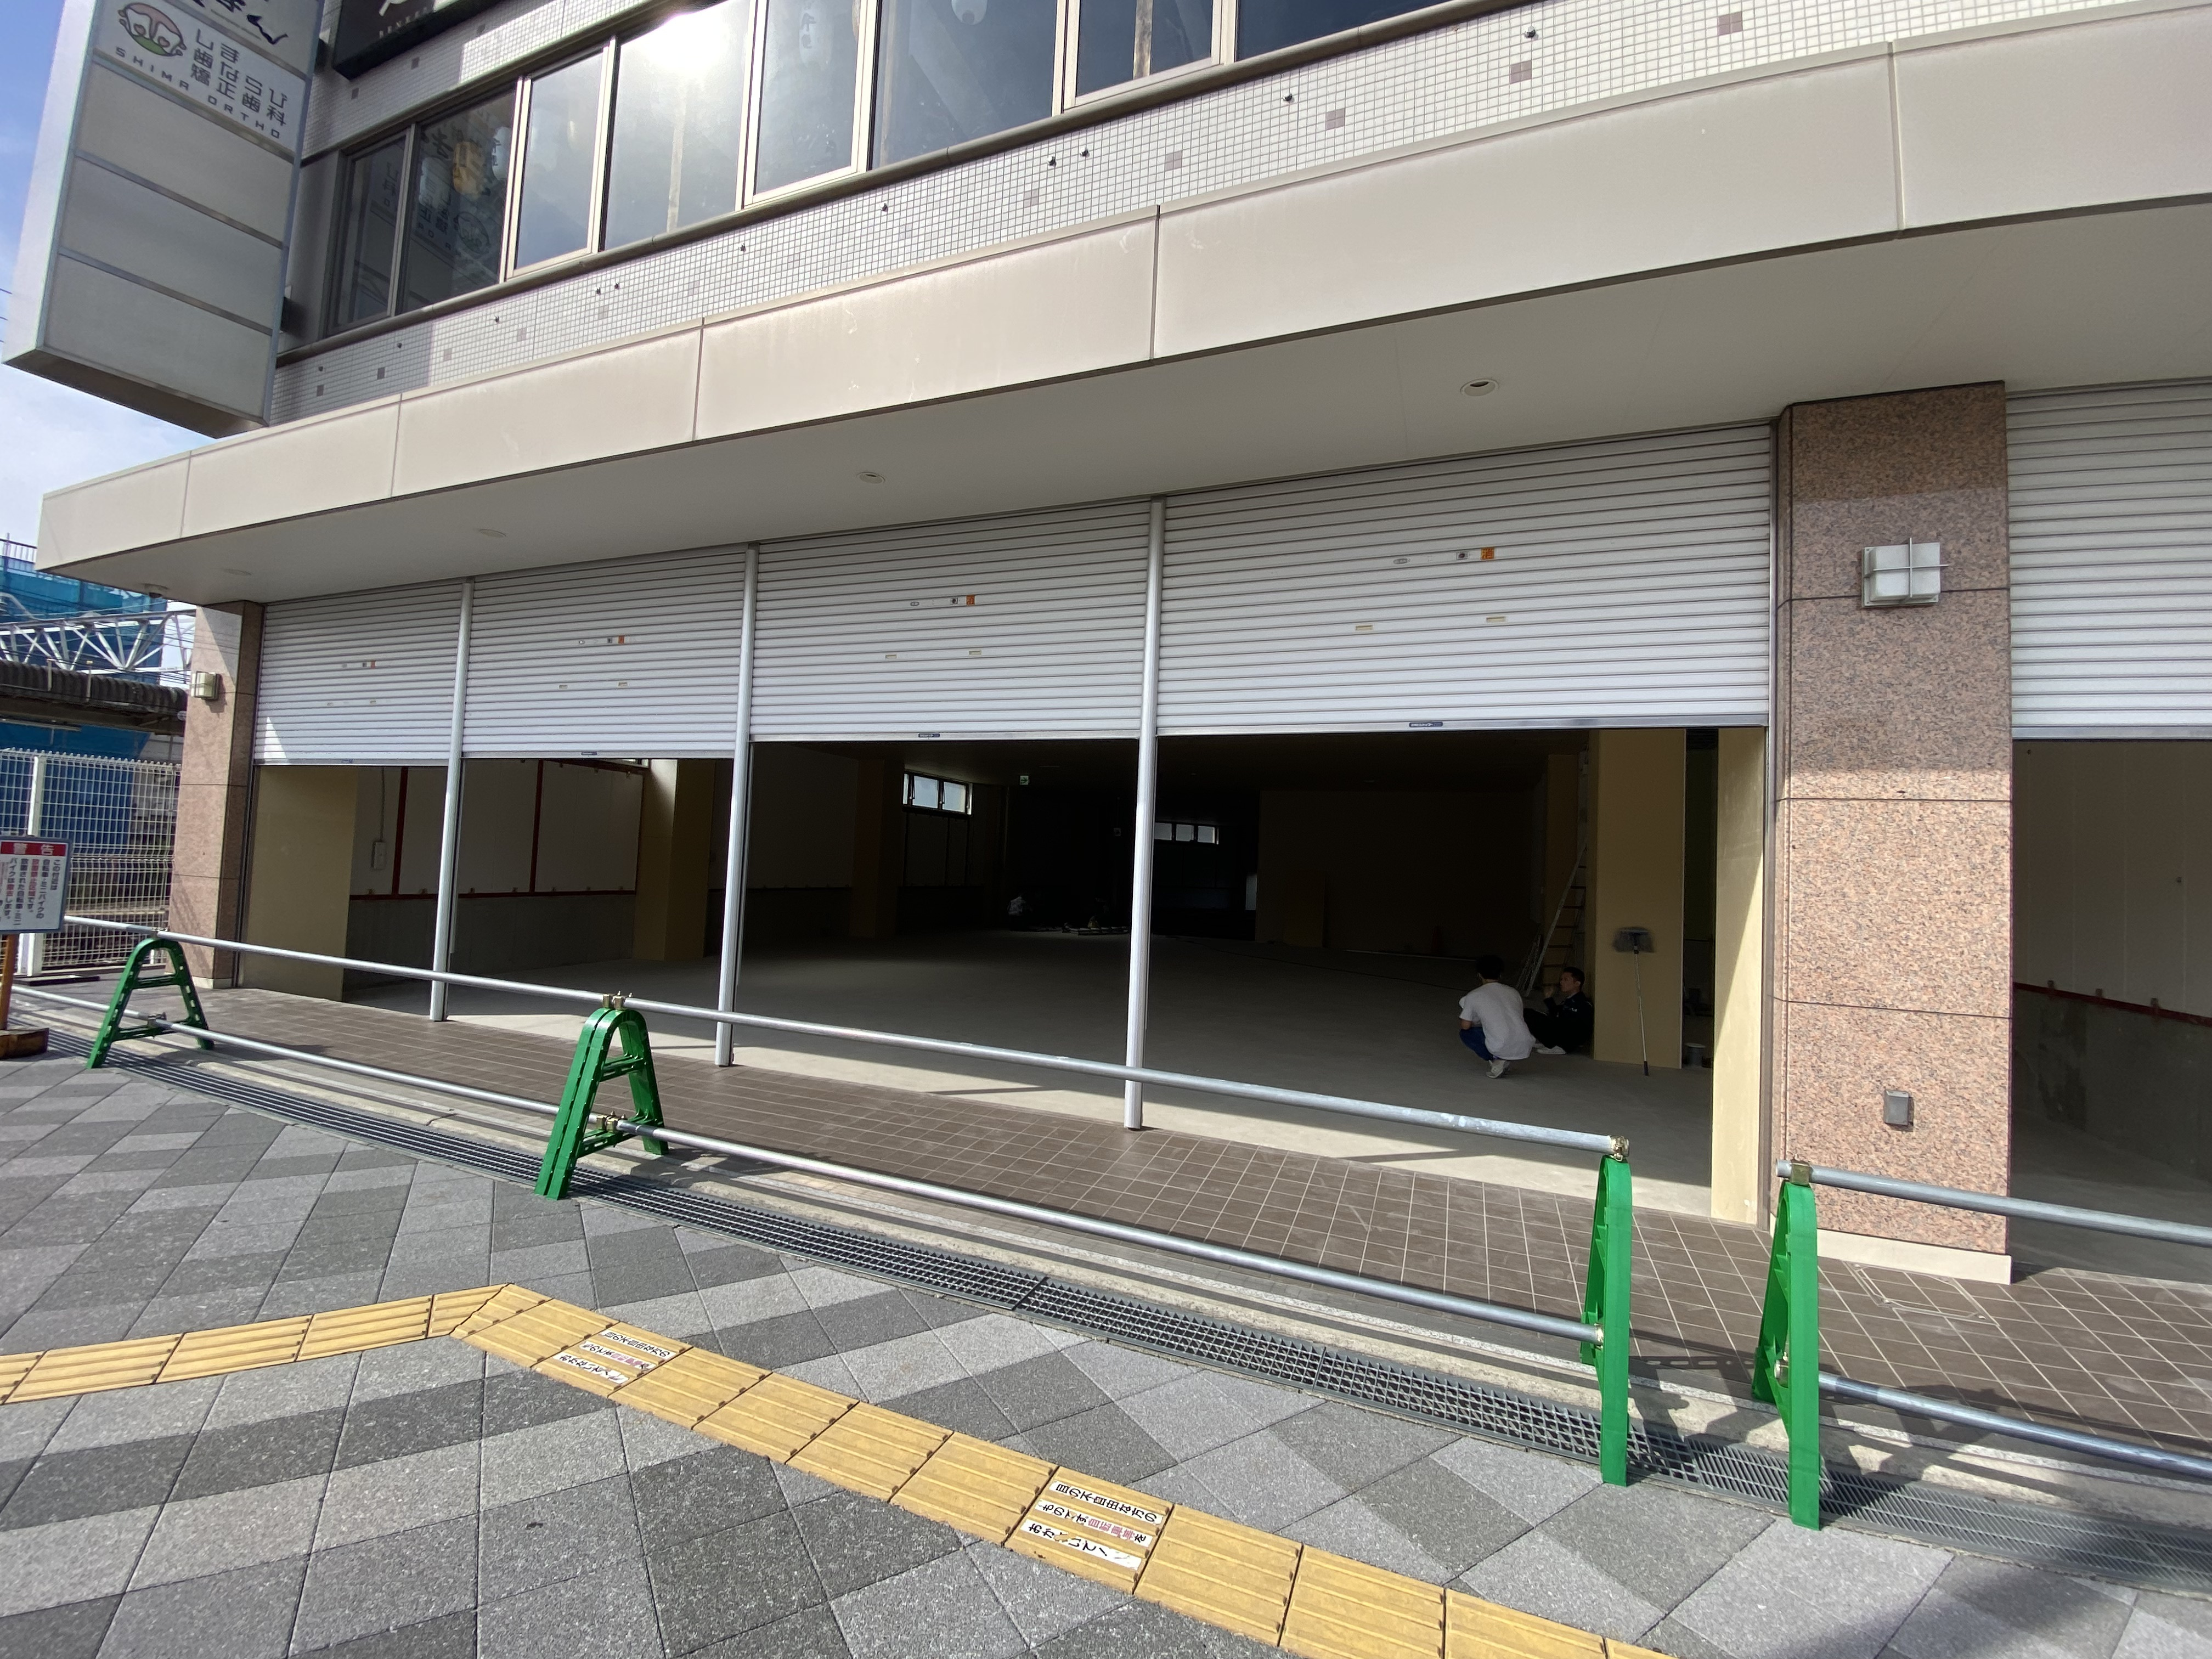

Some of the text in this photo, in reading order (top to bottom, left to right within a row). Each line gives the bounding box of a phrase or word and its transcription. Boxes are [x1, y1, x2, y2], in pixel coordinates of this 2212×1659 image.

[116, 46, 280, 139] SHIMA ORTHO
[189, 64, 286, 127] 矯正歯科
[1056, 1483, 1157, 1522] 目の不自由な方の
[1029, 1523, 1108, 1556] おかいで！
